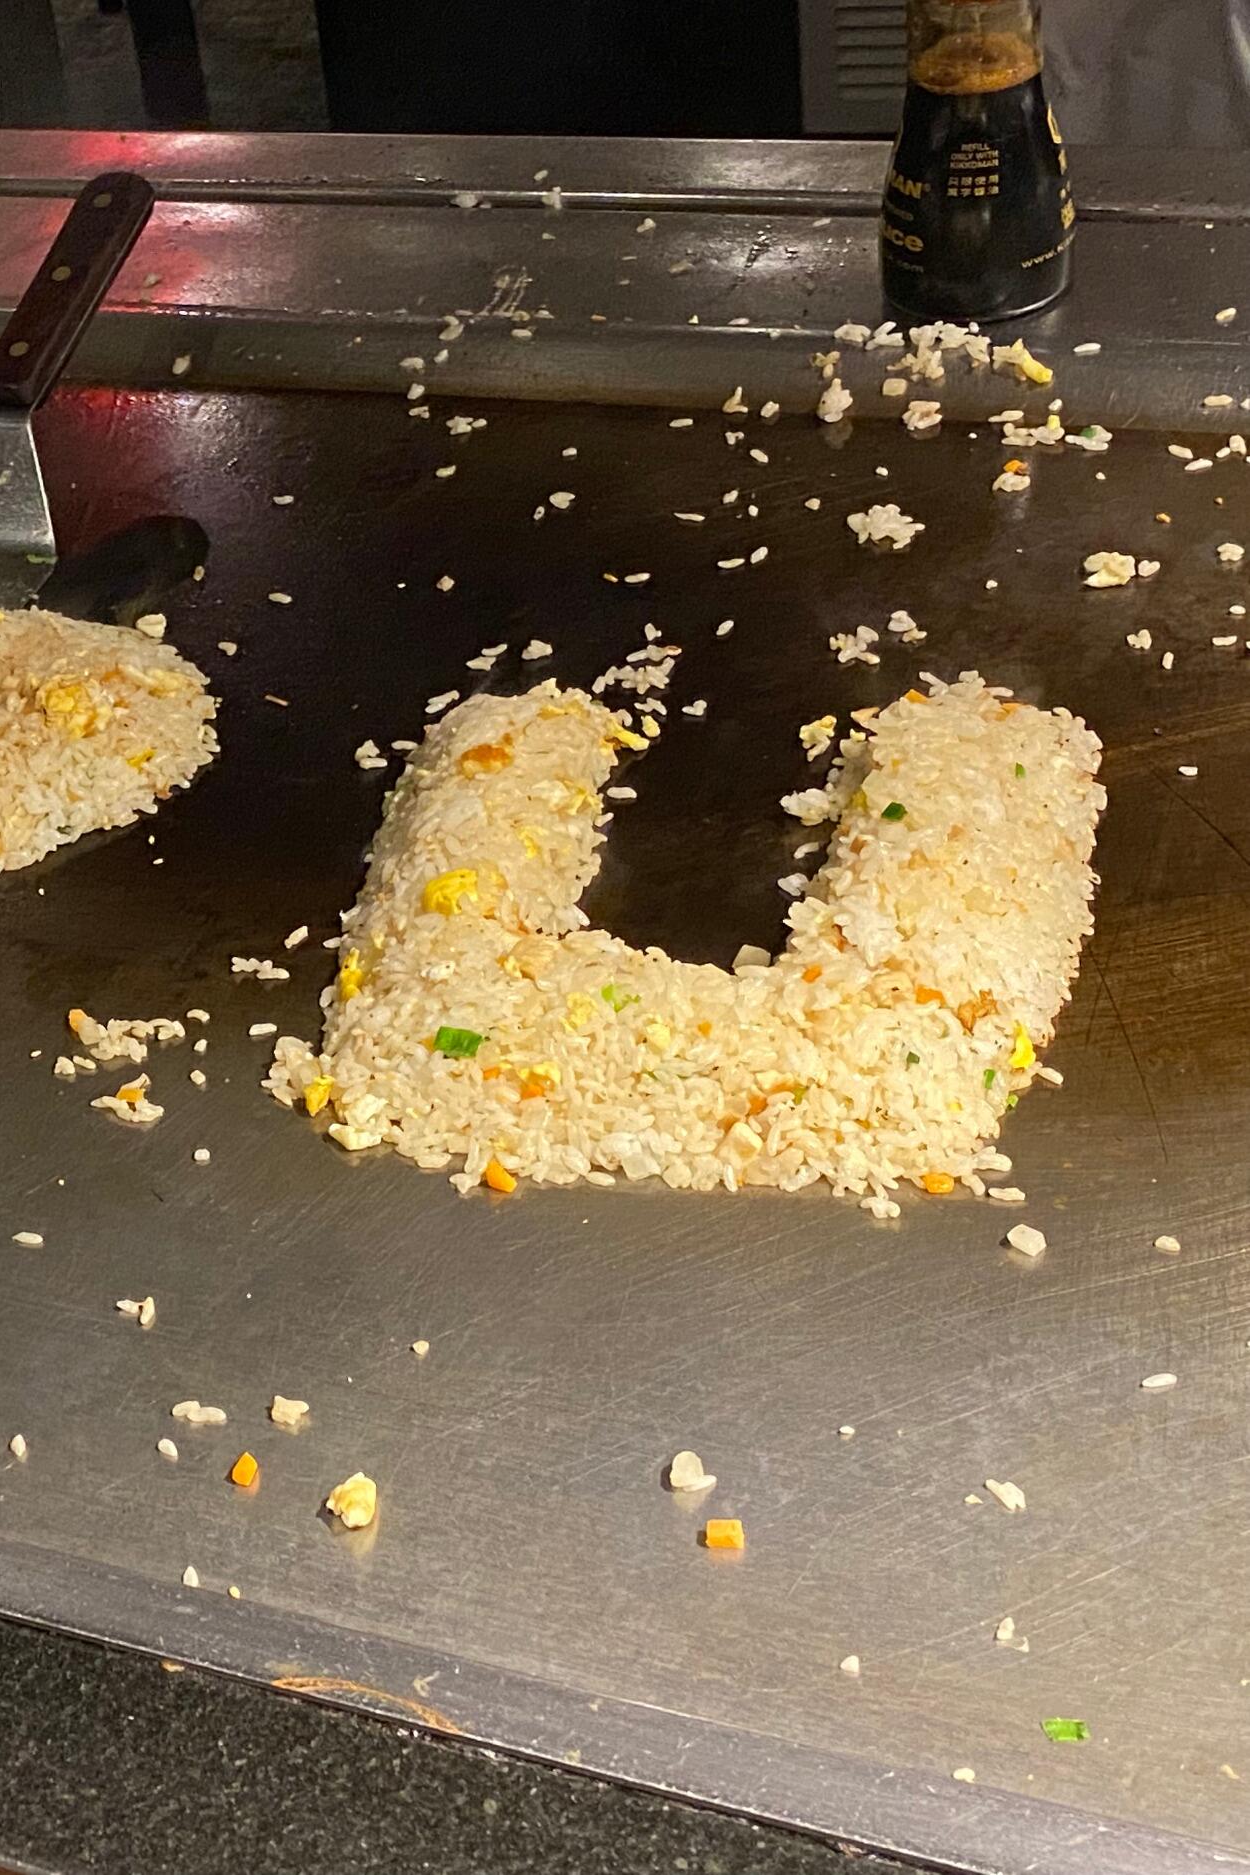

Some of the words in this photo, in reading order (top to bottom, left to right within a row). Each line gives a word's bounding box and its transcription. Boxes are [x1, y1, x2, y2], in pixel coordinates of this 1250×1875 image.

[950, 152, 974, 161] ONLY
[975, 149, 999, 160] WITH
[950, 158, 999, 169] KIKKOMAN
